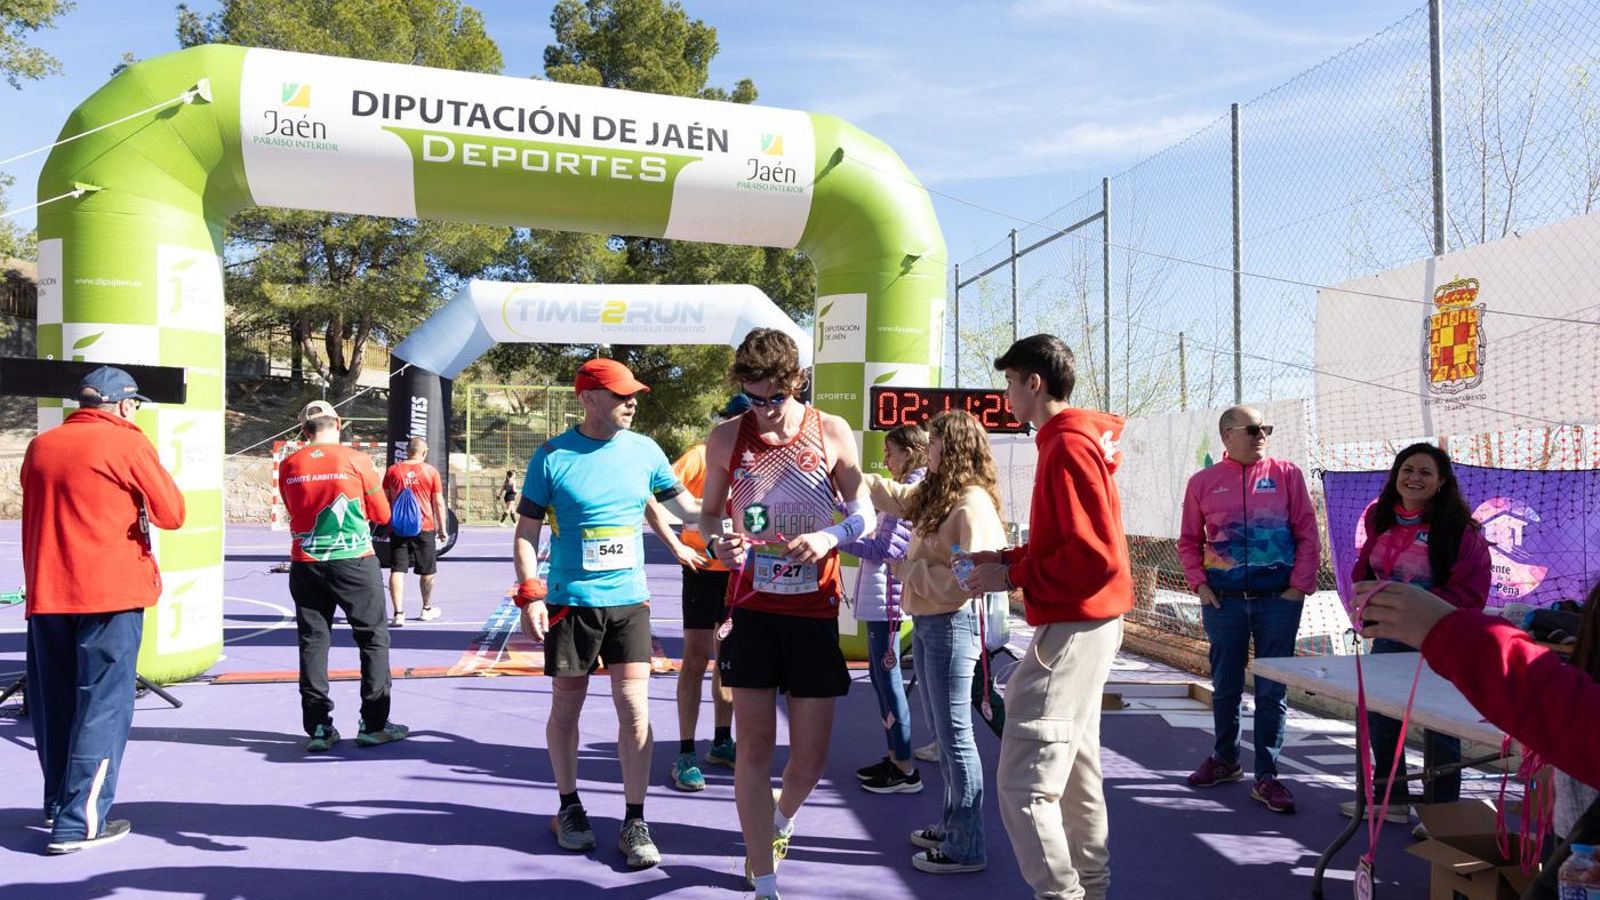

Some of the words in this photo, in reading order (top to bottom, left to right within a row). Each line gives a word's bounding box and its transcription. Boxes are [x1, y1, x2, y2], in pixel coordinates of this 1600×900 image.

[264, 110, 327, 140] Jaén
[352, 89, 581, 138] DIPUTACIÓN
[593, 116, 637, 144] DE
[646, 122, 729, 153] JAÉN
[295, 140, 339, 152] INTERIOR
[747, 158, 797, 184] Jaén
[514, 299, 705, 324] TIME2RUN
[825, 324, 860, 333] DIPUTACIÓN
[312, 472, 349, 481] ARBITRAL
[599, 543, 625, 556] 542
[773, 563, 802, 578] 627
[1491, 564, 1511, 575] ente
